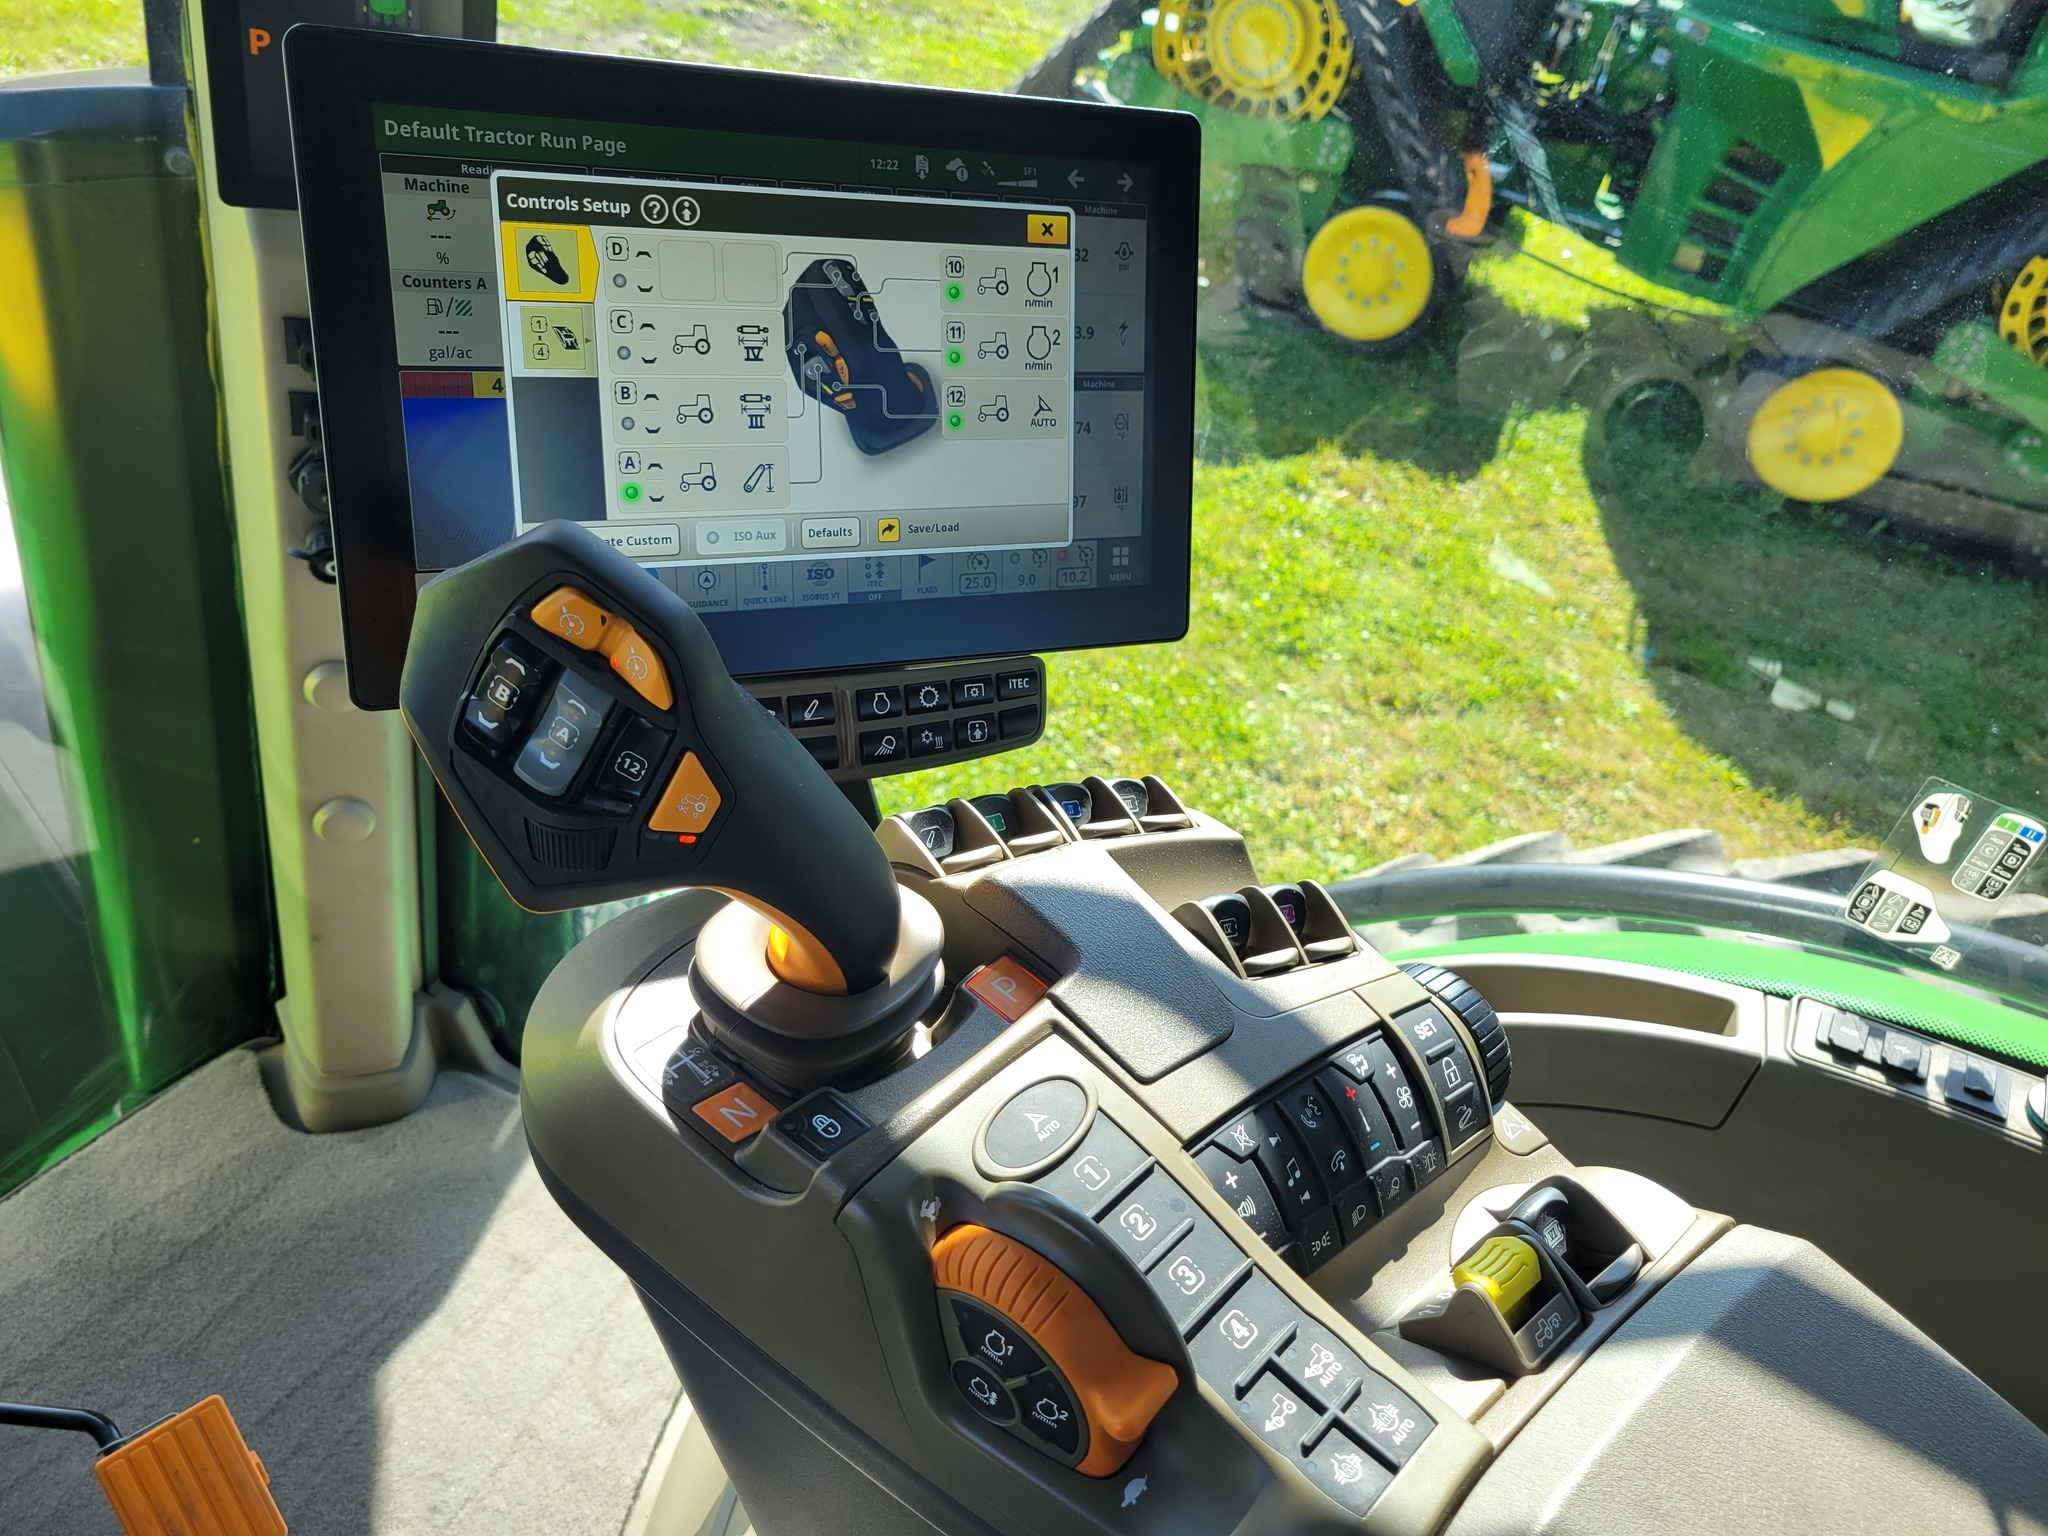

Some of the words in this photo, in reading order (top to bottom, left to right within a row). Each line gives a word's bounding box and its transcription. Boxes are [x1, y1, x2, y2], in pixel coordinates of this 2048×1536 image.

[249, 28, 271, 56] P
[384, 119, 460, 141] Default
[464, 126, 535, 146] Tractor
[540, 132, 577, 150] Run
[582, 135, 627, 157] Page
[870, 158, 899, 171] 12:22
[404, 177, 470, 194] Machine
[506, 193, 579, 212] Controls
[582, 197, 631, 218] Setup
[1084, 205, 1118, 216] Machine
[612, 242, 623, 256] D
[948, 260, 962, 274] 10
[1118, 263, 1130, 273] psi
[402, 274, 472, 290] Counters
[476, 277, 488, 290] A
[1052, 266, 1059, 284] 1
[1025, 298, 1053, 309] n/min
[616, 314, 627, 329] C
[949, 326, 962, 339] 11
[1052, 329, 1061, 346] 2
[429, 346, 473, 362] gal/ac
[744, 346, 764, 361] IV
[1025, 361, 1053, 371] n/min
[1083, 380, 1116, 389] Machine
[621, 386, 631, 400] B
[949, 390, 963, 403] 12
[748, 414, 765, 429] III
[1030, 418, 1057, 427] AUTO
[624, 456, 636, 470] A
[808, 526, 853, 538] Defaults
[907, 521, 960, 534] Save/Load
[626, 535, 672, 546] Custom
[734, 531, 753, 542] ISO
[755, 530, 777, 541] Aux
[806, 567, 835, 581] ISO
[1018, 573, 1036, 586] 9.0
[1062, 570, 1087, 583] 10.2
[1109, 573, 1132, 581] MENU
[917, 586, 938, 594] FLAGS
[964, 576, 992, 590] 25.0
[687, 599, 729, 608] GUIDANCE
[743, 596, 768, 606] QUICK
[769, 595, 788, 604] LINE
[802, 593, 830, 601] ISOBUS
[831, 592, 841, 600] VT
[1008, 678, 1030, 689] iTEC
[497, 686, 511, 701] B
[555, 728, 569, 743] A
[623, 757, 642, 775] 12
[990, 976, 1017, 1003] P
[1413, 1017, 1438, 1040] SET
[719, 1096, 758, 1128] N
[1036, 1119, 1061, 1142] AUTO
[1083, 1164, 1102, 1181] 1
[1128, 1213, 1151, 1234] 2
[1177, 1265, 1197, 1286] 3
[1230, 1318, 1251, 1339] 4
[980, 1344, 1004, 1366] n/min
[1006, 1345, 1014, 1356] 1
[1319, 1361, 1343, 1388] AUTO
[968, 1386, 989, 1406] n/min
[1031, 1410, 1058, 1428] n/min
[1059, 1410, 1069, 1421] 2
[1391, 1418, 1416, 1446] AUTO
